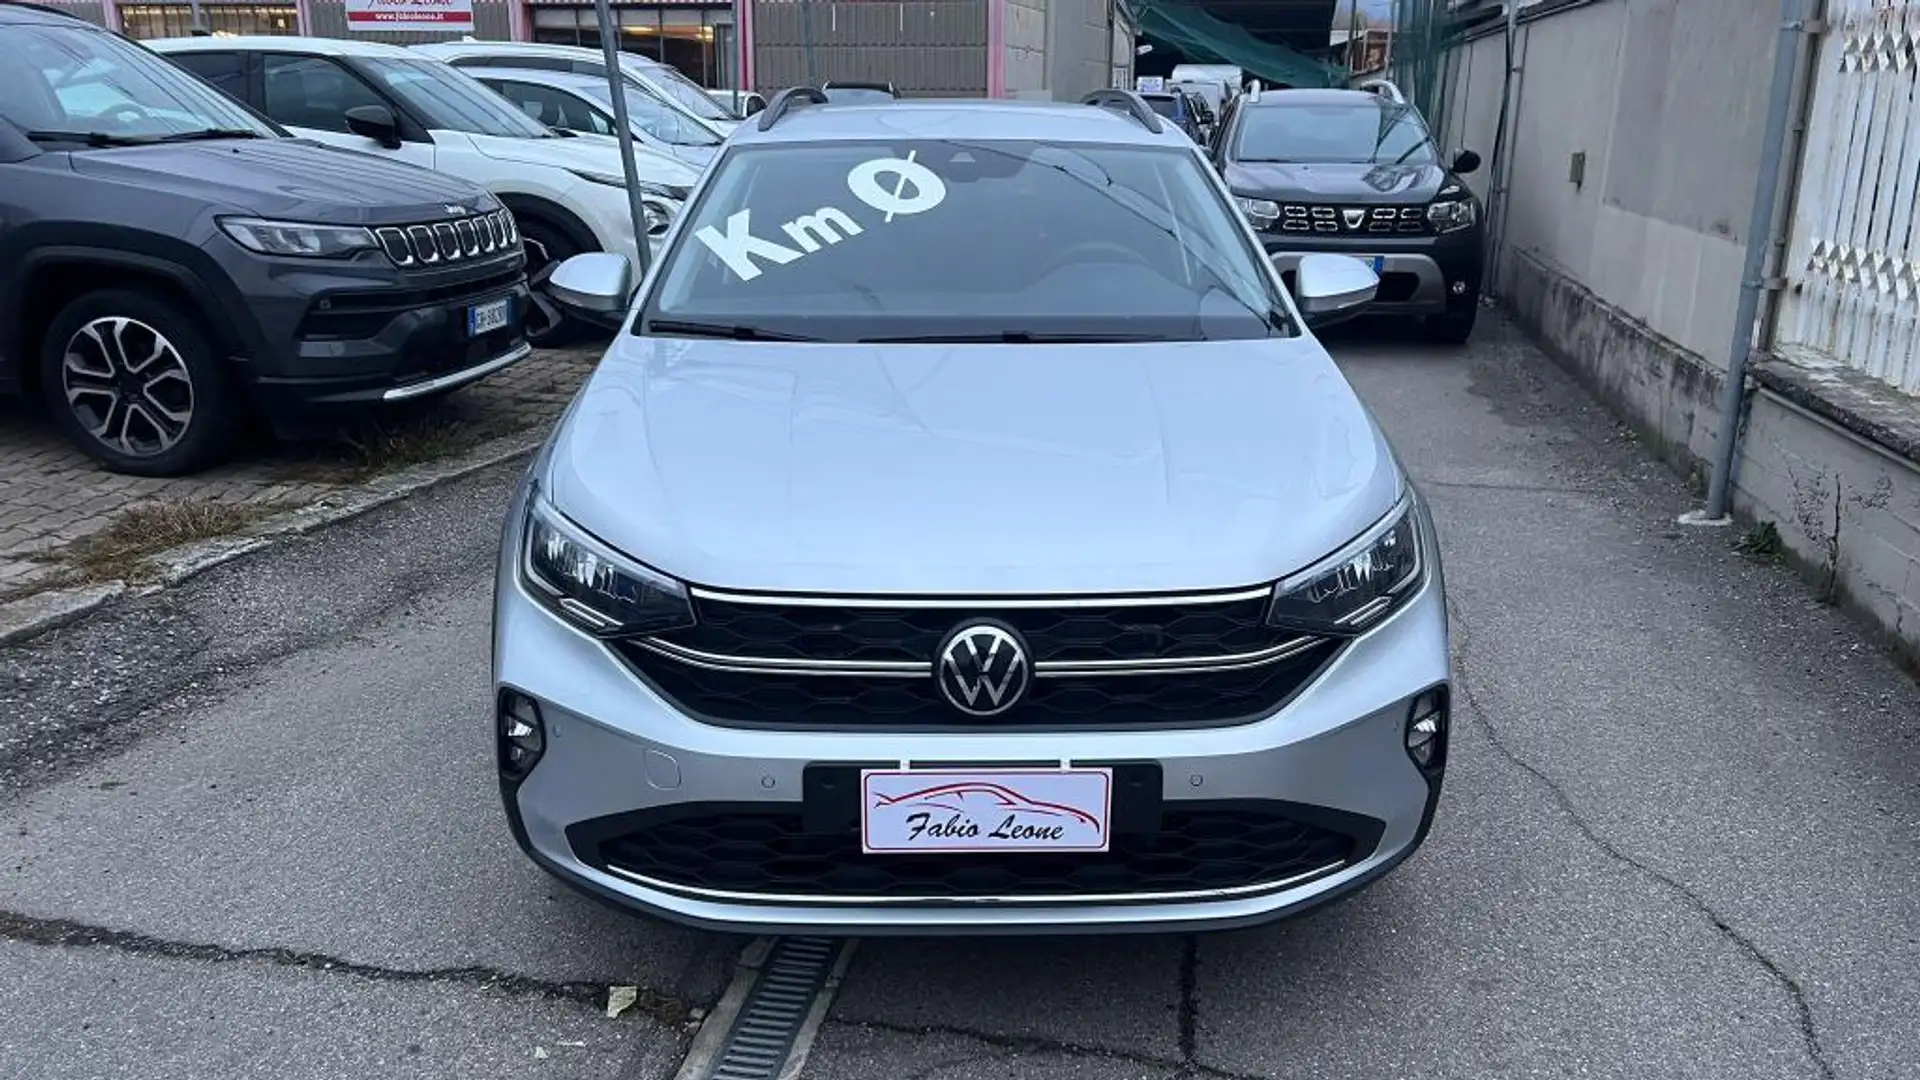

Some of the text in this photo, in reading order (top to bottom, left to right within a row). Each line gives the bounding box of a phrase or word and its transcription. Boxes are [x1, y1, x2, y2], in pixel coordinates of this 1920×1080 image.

[695, 208, 864, 281] Km
[906, 812, 1064, 841] Fabio Leone
